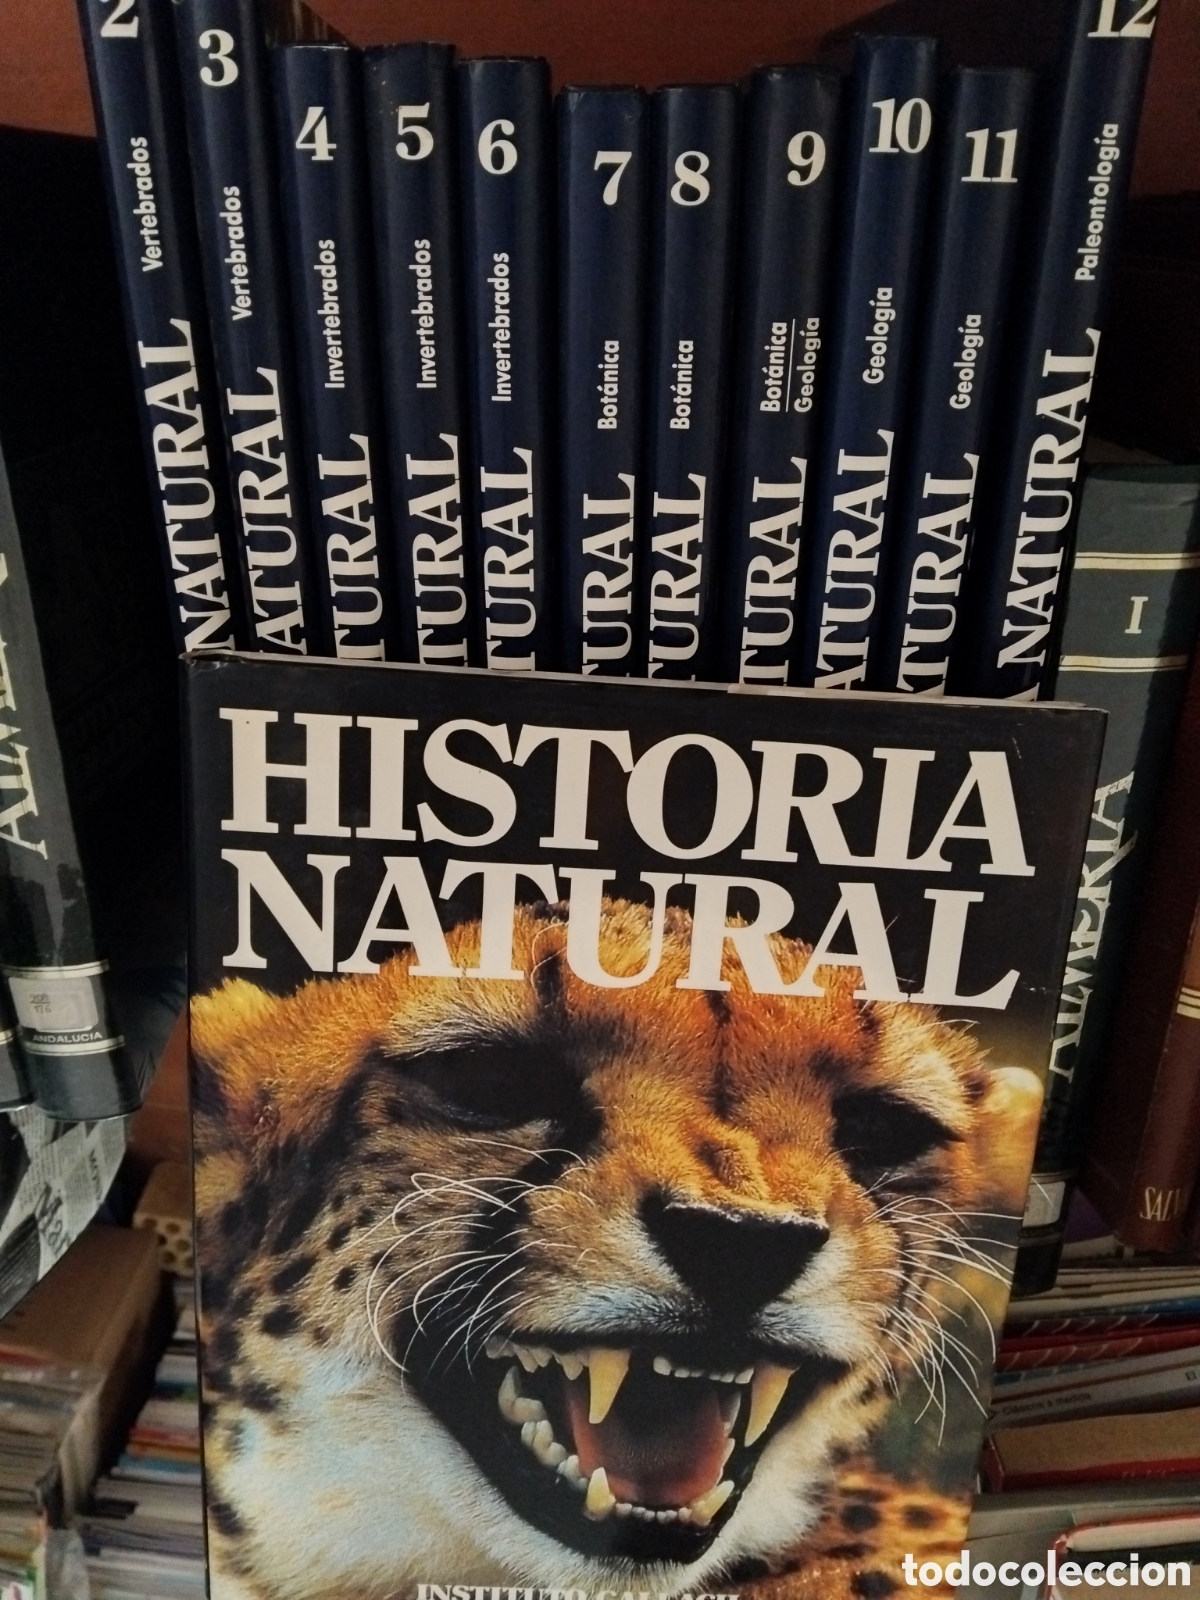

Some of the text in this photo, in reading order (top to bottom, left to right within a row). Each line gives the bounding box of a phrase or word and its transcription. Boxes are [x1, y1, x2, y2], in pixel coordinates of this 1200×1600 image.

[99, 0, 139, 38] 2
[198, 28, 239, 87] 3
[1087, 0, 1158, 38] 12
[295, 106, 337, 161] 4
[395, 102, 434, 161] 5
[477, 119, 518, 175] 6
[787, 130, 826, 187] 9
[868, 97, 932, 154] 10
[960, 128, 1018, 183] 11
[126, 136, 164, 272] Vertebrados
[593, 150, 633, 206] 7
[670, 150, 710, 207] 8
[1074, 123, 1120, 281] Paleontología
[219, 185, 253, 321] Vertebrados
[313, 239, 346, 389] Invertebrados
[408, 239, 437, 389] Invertebrados
[486, 252, 512, 402] Invertebrados
[862, 287, 897, 384] Geología
[596, 340, 620, 430] Botánica
[669, 340, 694, 430] Botánica
[759, 321, 788, 413] Botánica
[794, 317, 821, 413] Geología
[949, 314, 984, 410] Geología
[139, 318, 236, 652] NATURAL
[226, 366, 308, 655] ATURAL
[996, 327, 1101, 667] NATURAL
[1125, 596, 1149, 634] I
[219, 707, 1036, 878] HISTORIA
[220, 848, 1021, 1010] NATURAL
